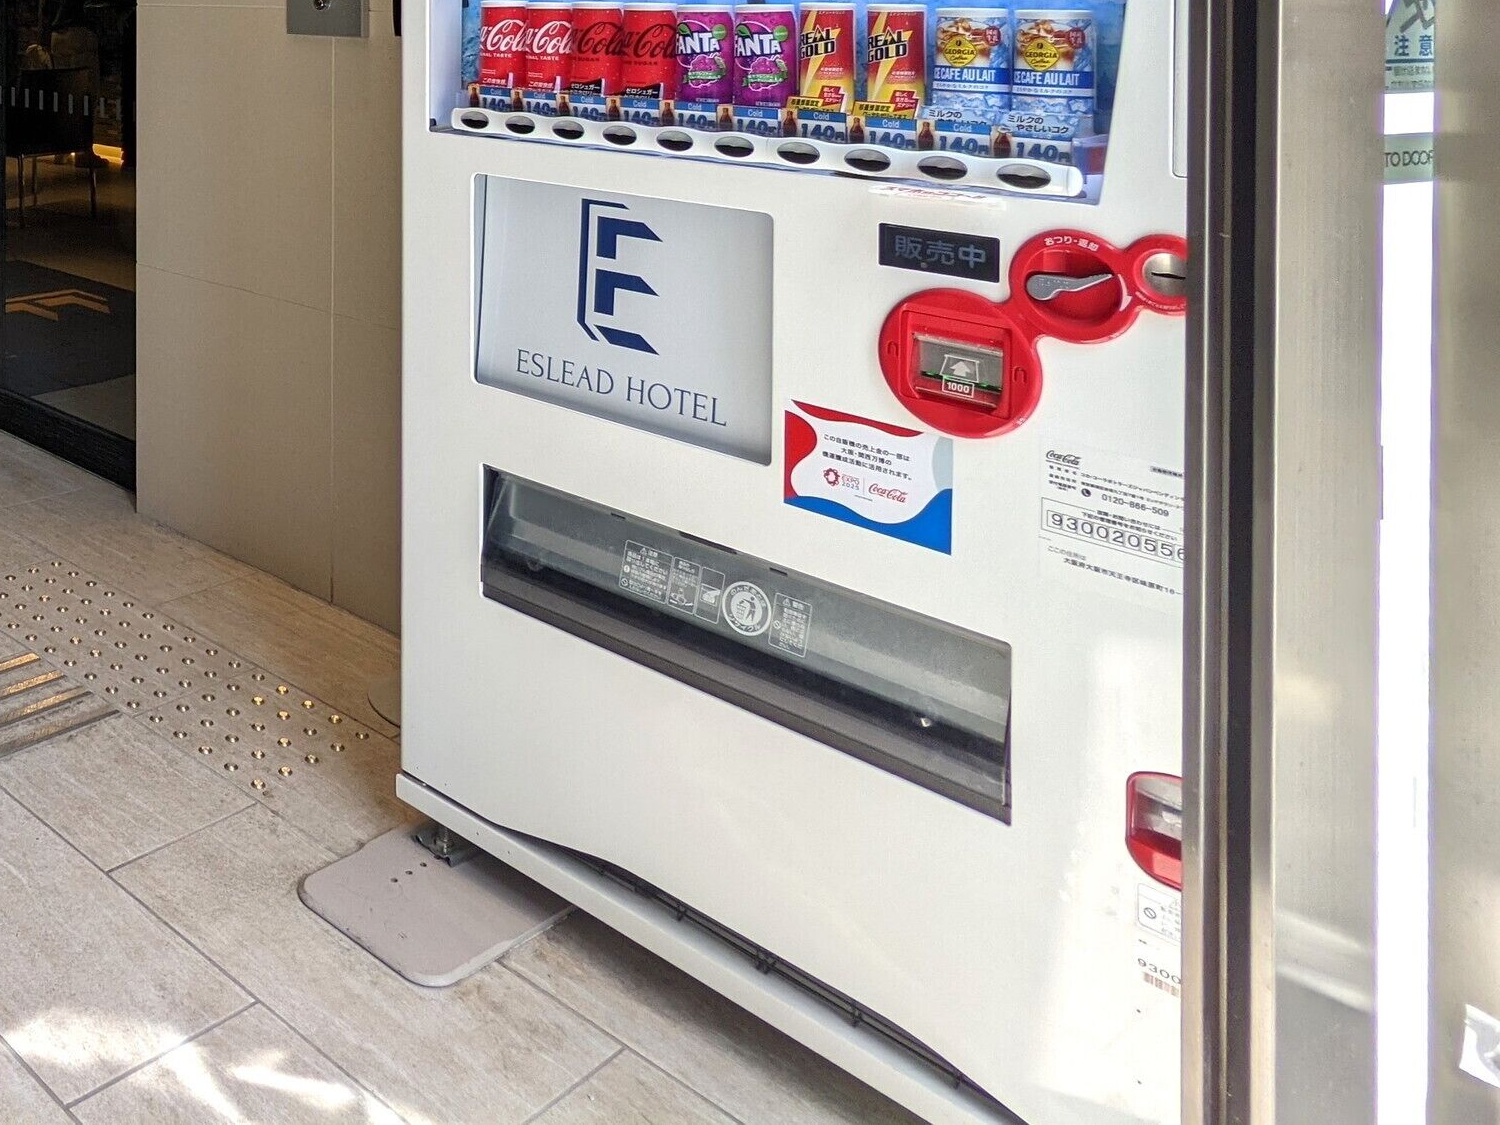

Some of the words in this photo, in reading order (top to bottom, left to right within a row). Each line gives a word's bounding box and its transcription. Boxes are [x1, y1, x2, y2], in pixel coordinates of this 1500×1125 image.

[800, 25, 836, 43] REAL
[867, 27, 908, 48] REAL
[800, 40, 836, 60] GOLD
[944, 48, 975, 57] GEORGIA
[1393, 35, 1434, 57] 注意
[867, 44, 908, 64] GOLD
[1024, 51, 1058, 60] GEORGIA
[941, 68, 961, 82] CAFE
[962, 69, 975, 82] AU
[975, 70, 996, 83] LAIT
[1021, 72, 1043, 85] CAFE
[1044, 73, 1059, 86] AU
[1059, 74, 1080, 86] LAIT
[581, 96, 594, 104] Cold
[633, 100, 647, 108] Cold
[688, 103, 702, 111] Cold
[748, 109, 763, 118] Cold
[813, 111, 830, 121] Cold
[928, 110, 962, 119] ミルクの
[1007, 114, 1044, 125] ミルクの
[882, 119, 900, 129] Cold
[953, 123, 972, 133] Cold
[1017, 123, 1070, 135] やさしいコク
[1016, 141, 1071, 162] 140円
[894, 233, 987, 269] 販売中
[516, 348, 615, 395] ESLEAD
[626, 376, 727, 427] HOTEL
[946, 381, 971, 395] 1000
[823, 433, 911, 462] この自販機の売上金の一部は
[840, 447, 893, 466] 大阪・関西万博の
[1046, 449, 1082, 466] Coca-Cola
[841, 474, 860, 486] EXPO
[868, 483, 909, 504] Coca-Cola
